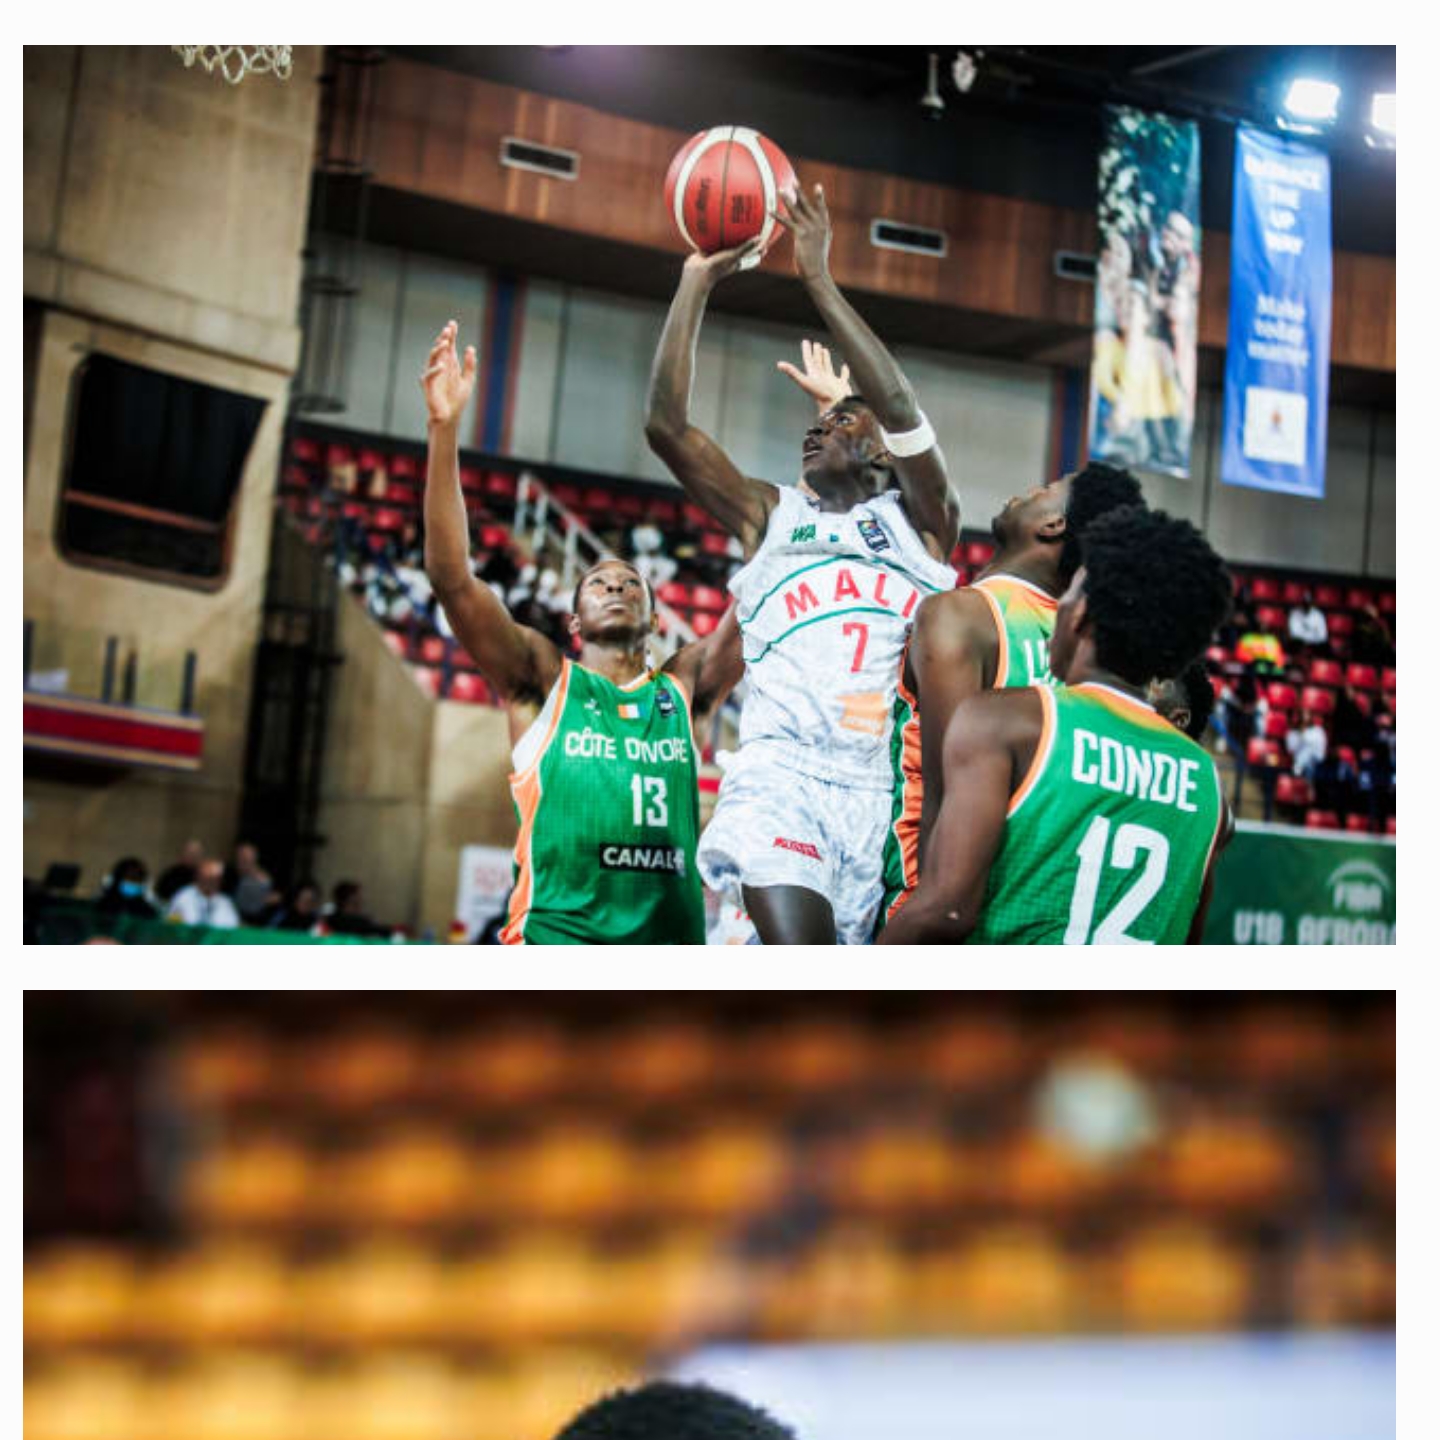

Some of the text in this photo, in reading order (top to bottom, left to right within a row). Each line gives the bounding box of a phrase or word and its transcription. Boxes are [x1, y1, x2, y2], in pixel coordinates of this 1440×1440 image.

[784, 567, 919, 620] MALI
[842, 621, 870, 674] 7
[564, 726, 617, 759] CÔTE
[1071, 728, 1199, 812] CONDE
[630, 773, 669, 827] 13
[1062, 815, 1171, 945] 12
